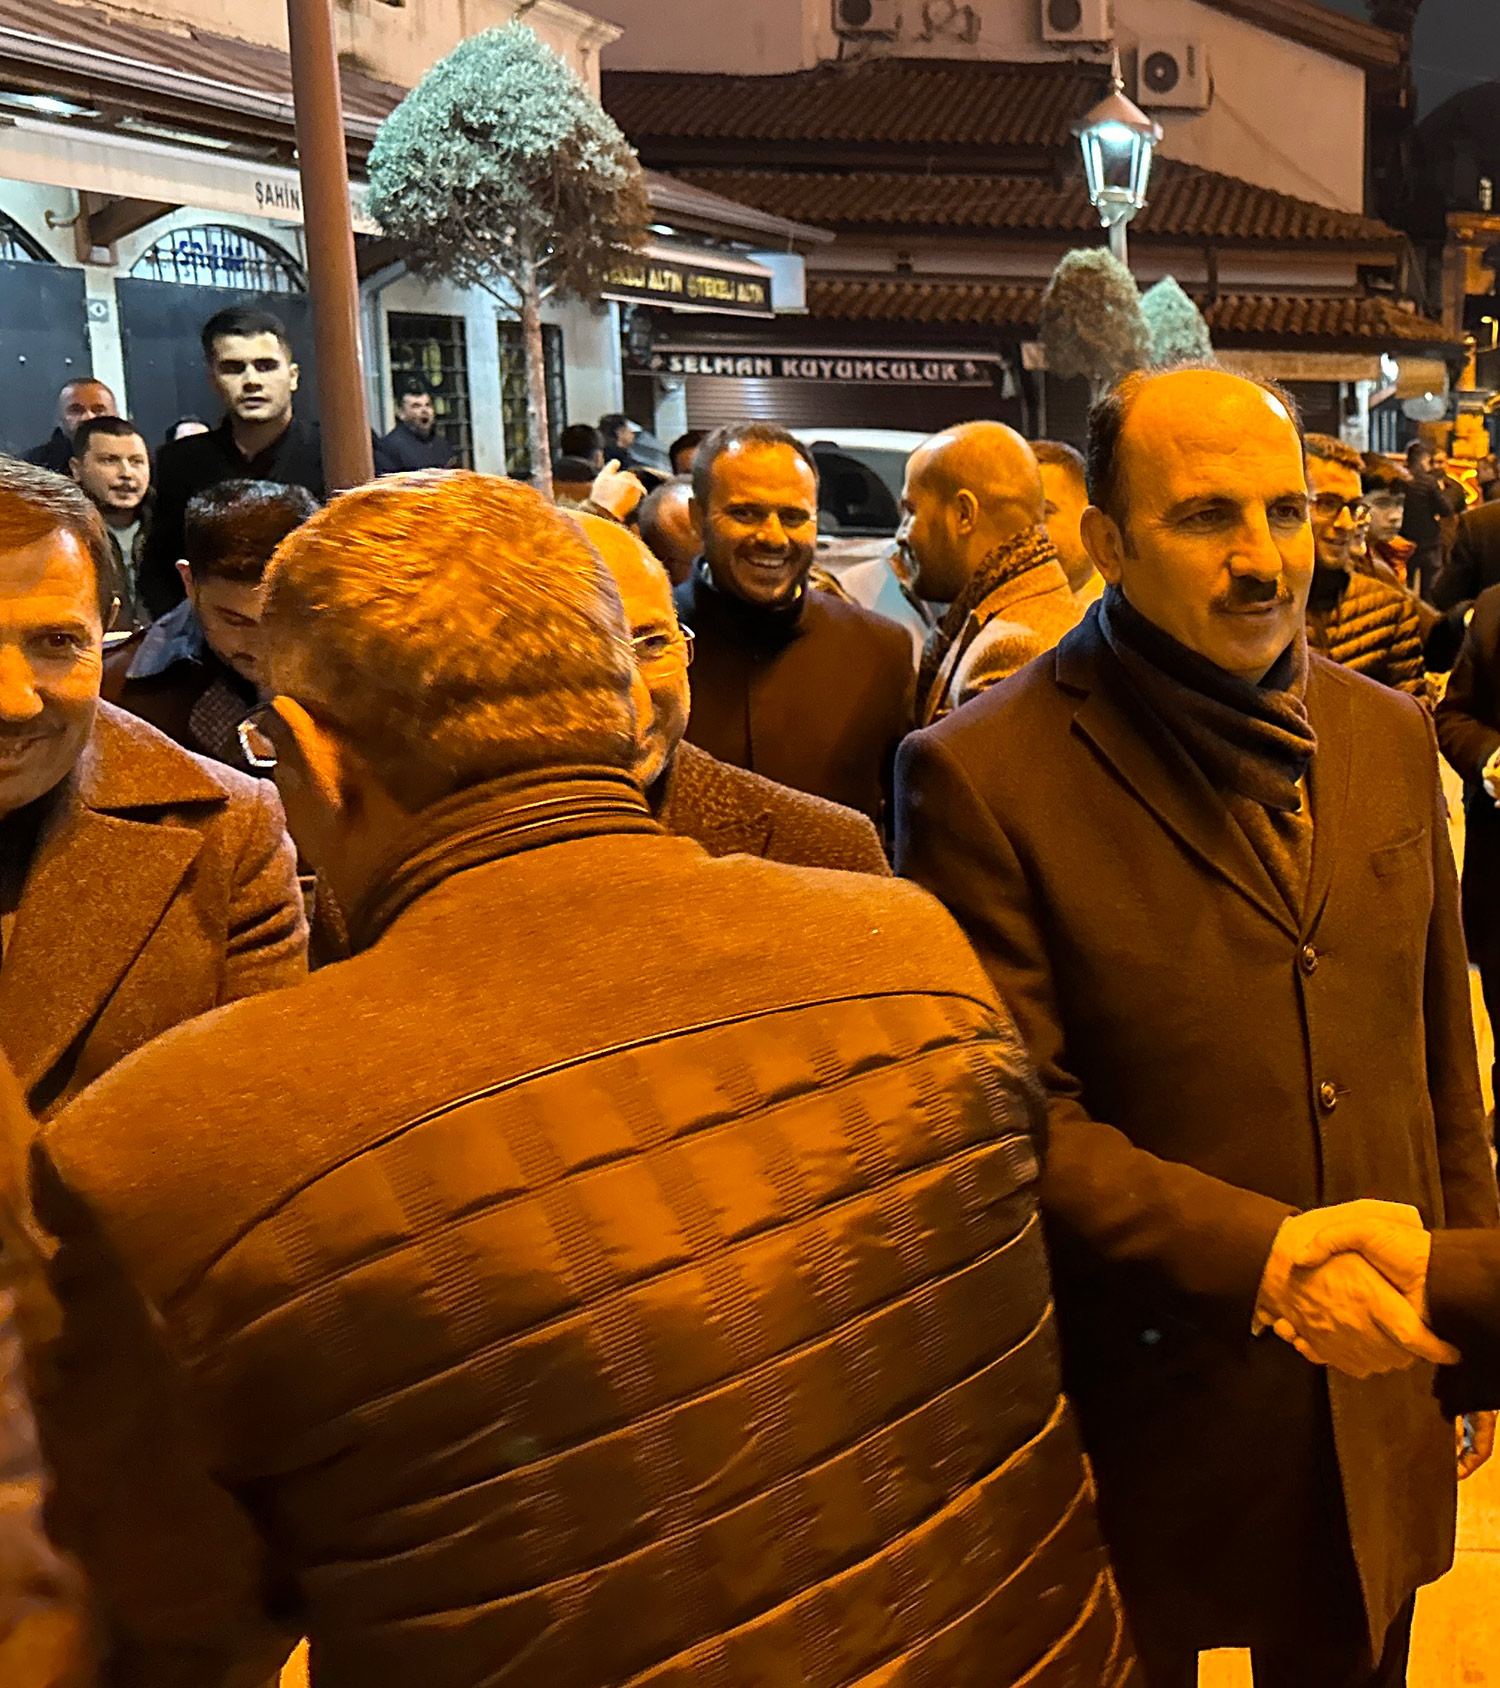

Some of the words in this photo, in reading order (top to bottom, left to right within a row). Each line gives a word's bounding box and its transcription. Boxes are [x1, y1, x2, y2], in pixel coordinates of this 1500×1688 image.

[255, 181, 300, 210] ŞAHİN
[668, 355, 772, 376] SELMAN
[780, 359, 957, 381] KUYUMCULUK
